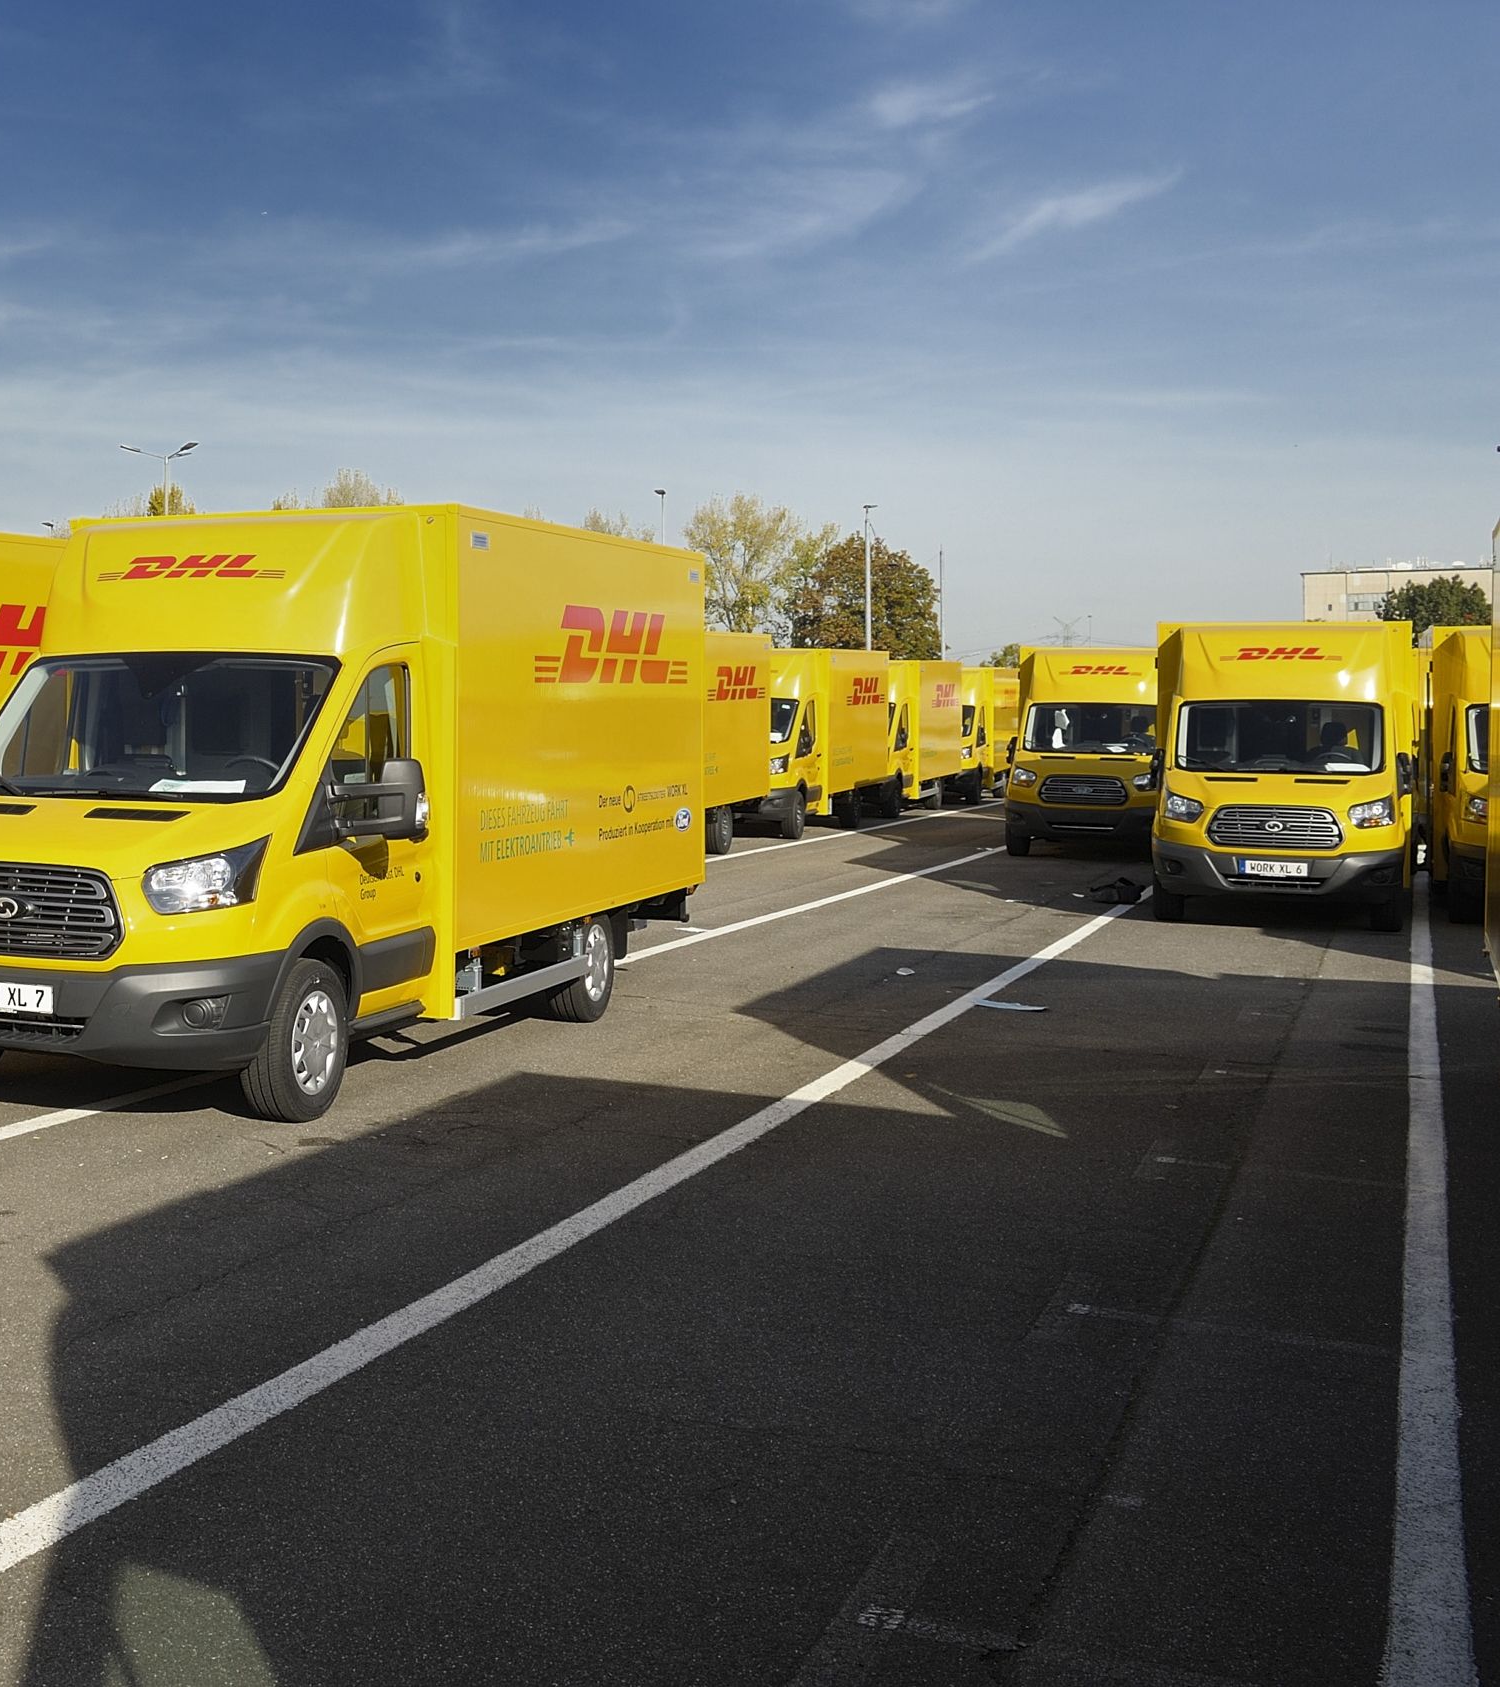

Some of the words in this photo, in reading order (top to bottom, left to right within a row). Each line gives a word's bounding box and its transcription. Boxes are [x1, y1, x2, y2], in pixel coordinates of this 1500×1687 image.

[120, 554, 257, 580] DHL
[558, 605, 671, 684] DHL
[1236, 647, 1327, 661] DHL
[1070, 665, 1130, 676] DHL
[716, 666, 759, 701] DHL
[852, 677, 881, 706] DHL
[935, 684, 957, 708] DHL
[480, 807, 506, 831] DIESES
[507, 802, 545, 827] FAHRZEUG
[480, 841, 494, 863] MIT
[1250, 863, 1275, 873] WORK
[1280, 865, 1291, 874] XL
[1296, 865, 1302, 874] 6
[7, 986, 27, 1007] XL
[35, 990, 45, 1008] 7
